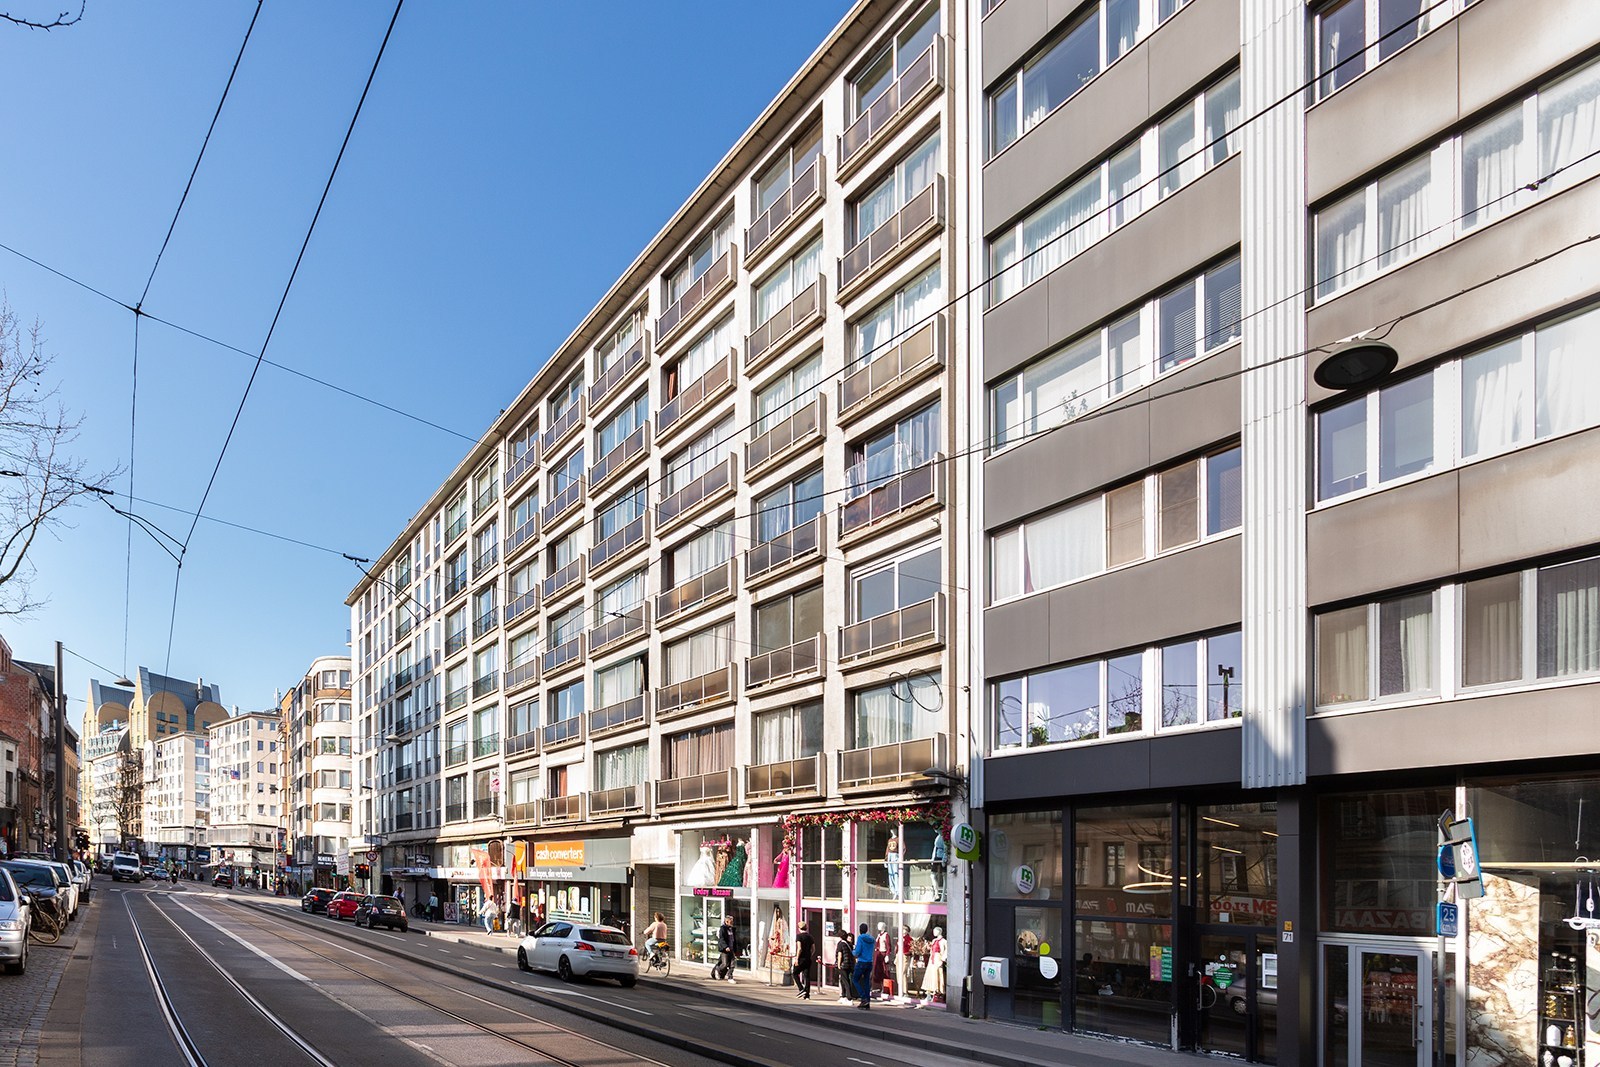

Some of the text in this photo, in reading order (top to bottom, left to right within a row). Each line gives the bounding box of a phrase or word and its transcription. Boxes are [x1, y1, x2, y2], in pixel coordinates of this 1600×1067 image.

[536, 845, 583, 860] cash converters
[1442, 907, 1456, 922] 25
[1283, 932, 1292, 941] 71
